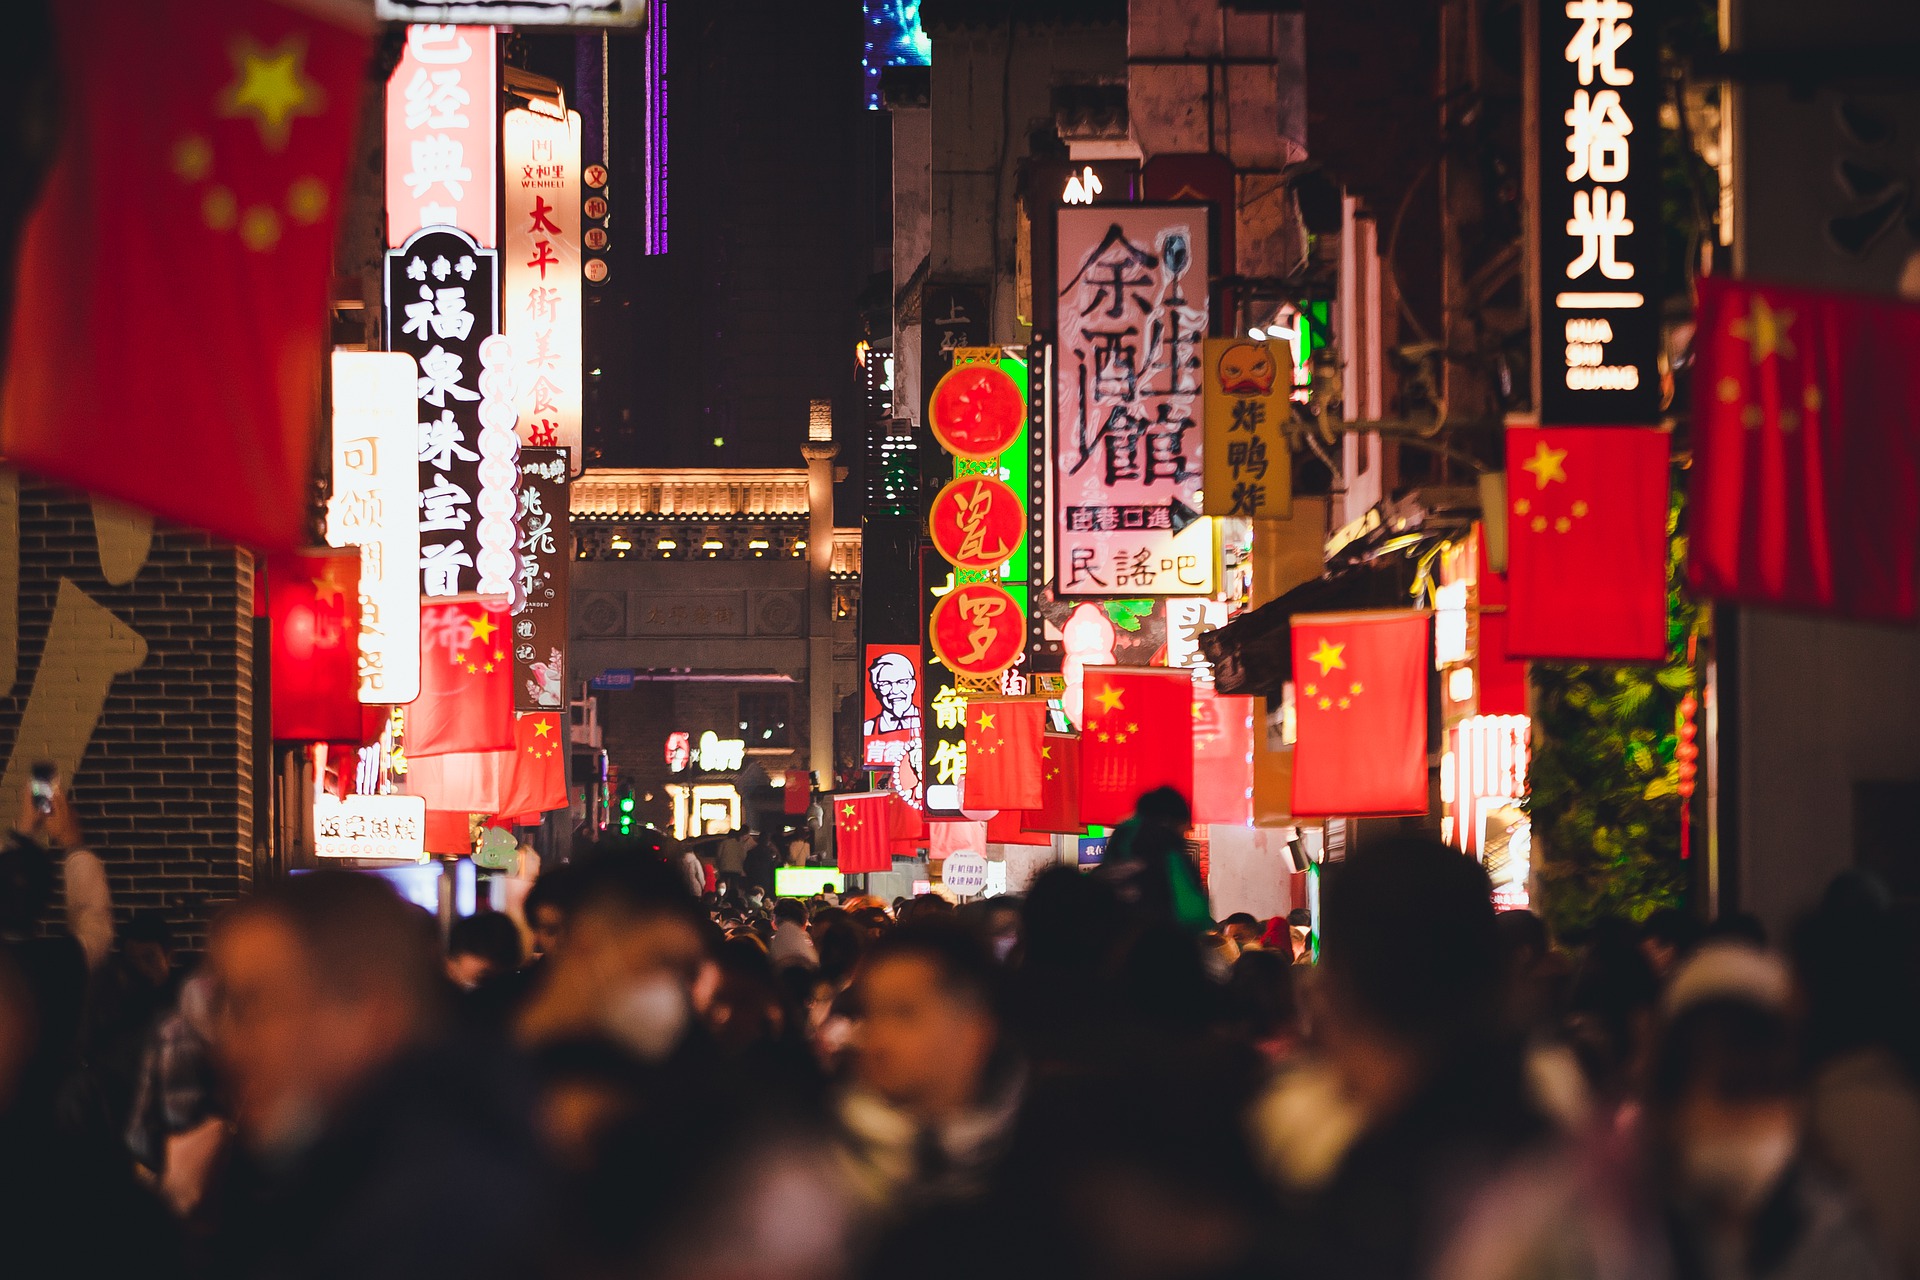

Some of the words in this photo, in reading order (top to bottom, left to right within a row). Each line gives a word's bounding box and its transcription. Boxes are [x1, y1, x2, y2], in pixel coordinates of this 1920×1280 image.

[521, 165, 564, 179] 文和里
[527, 196, 563, 446] 太平街美食城
[1227, 401, 1270, 516] 炸鸭炸
[1066, 547, 1206, 587] 民謠吧
